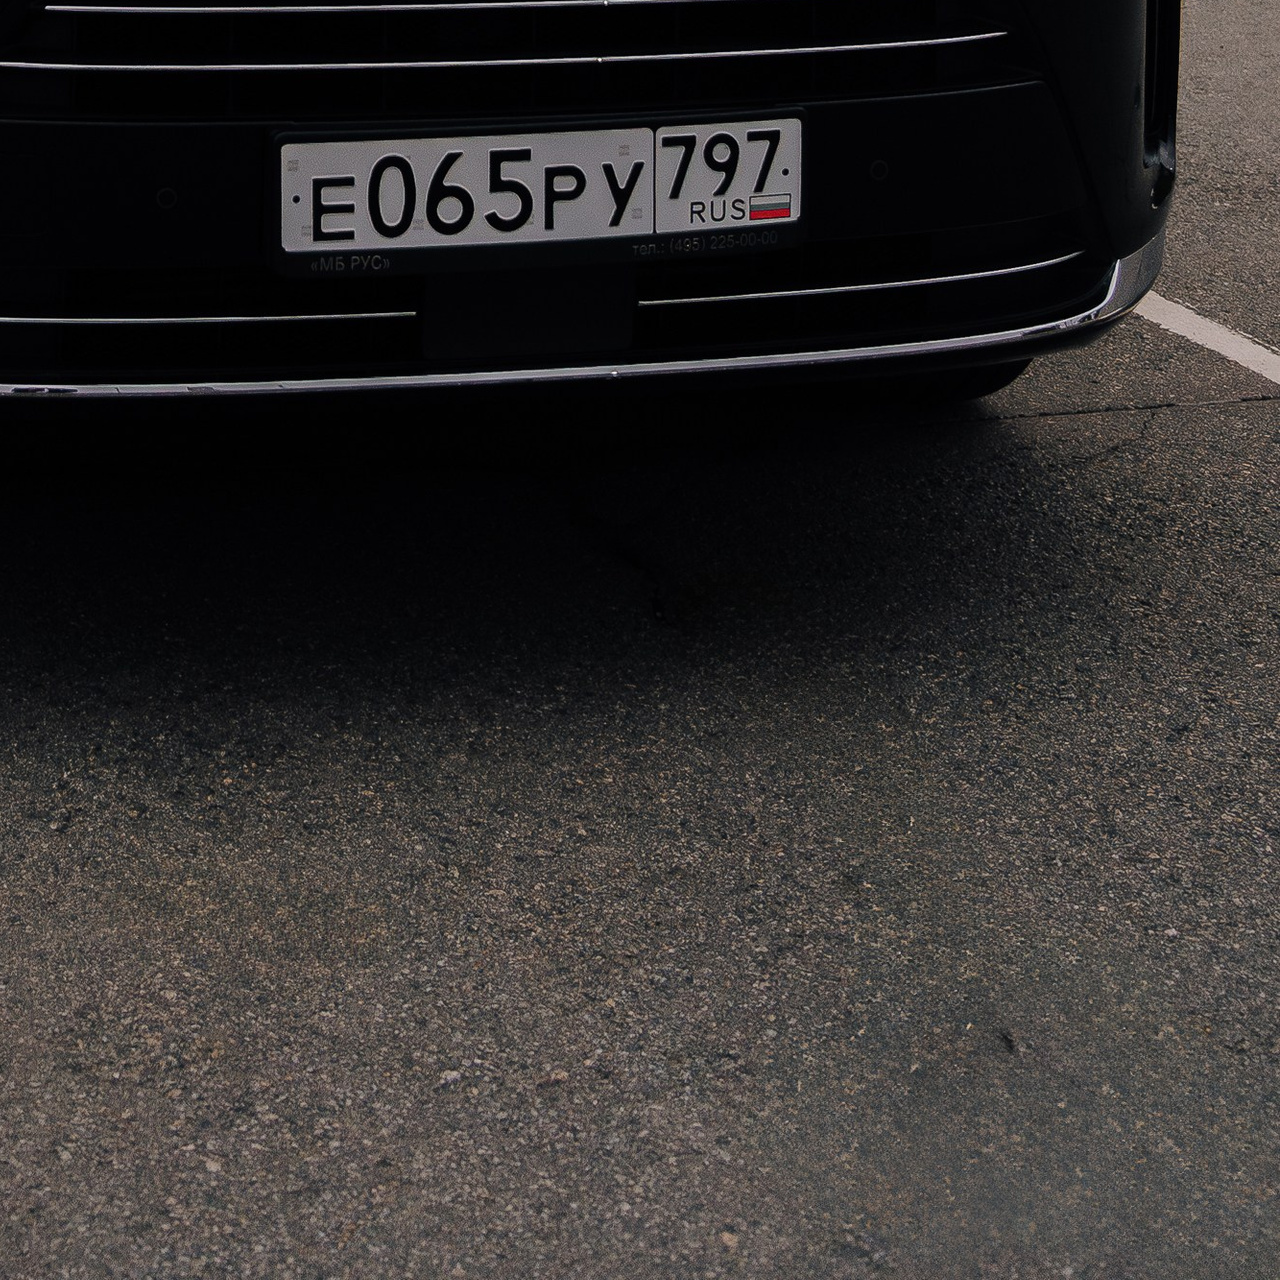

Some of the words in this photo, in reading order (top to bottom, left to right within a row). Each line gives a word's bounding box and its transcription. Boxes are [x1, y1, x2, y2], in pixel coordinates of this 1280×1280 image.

[661, 128, 781, 200] 797
[690, 198, 746, 224] RUS
[668, 236, 706, 255] (495)
[709, 230, 778, 251] 225-00-00
